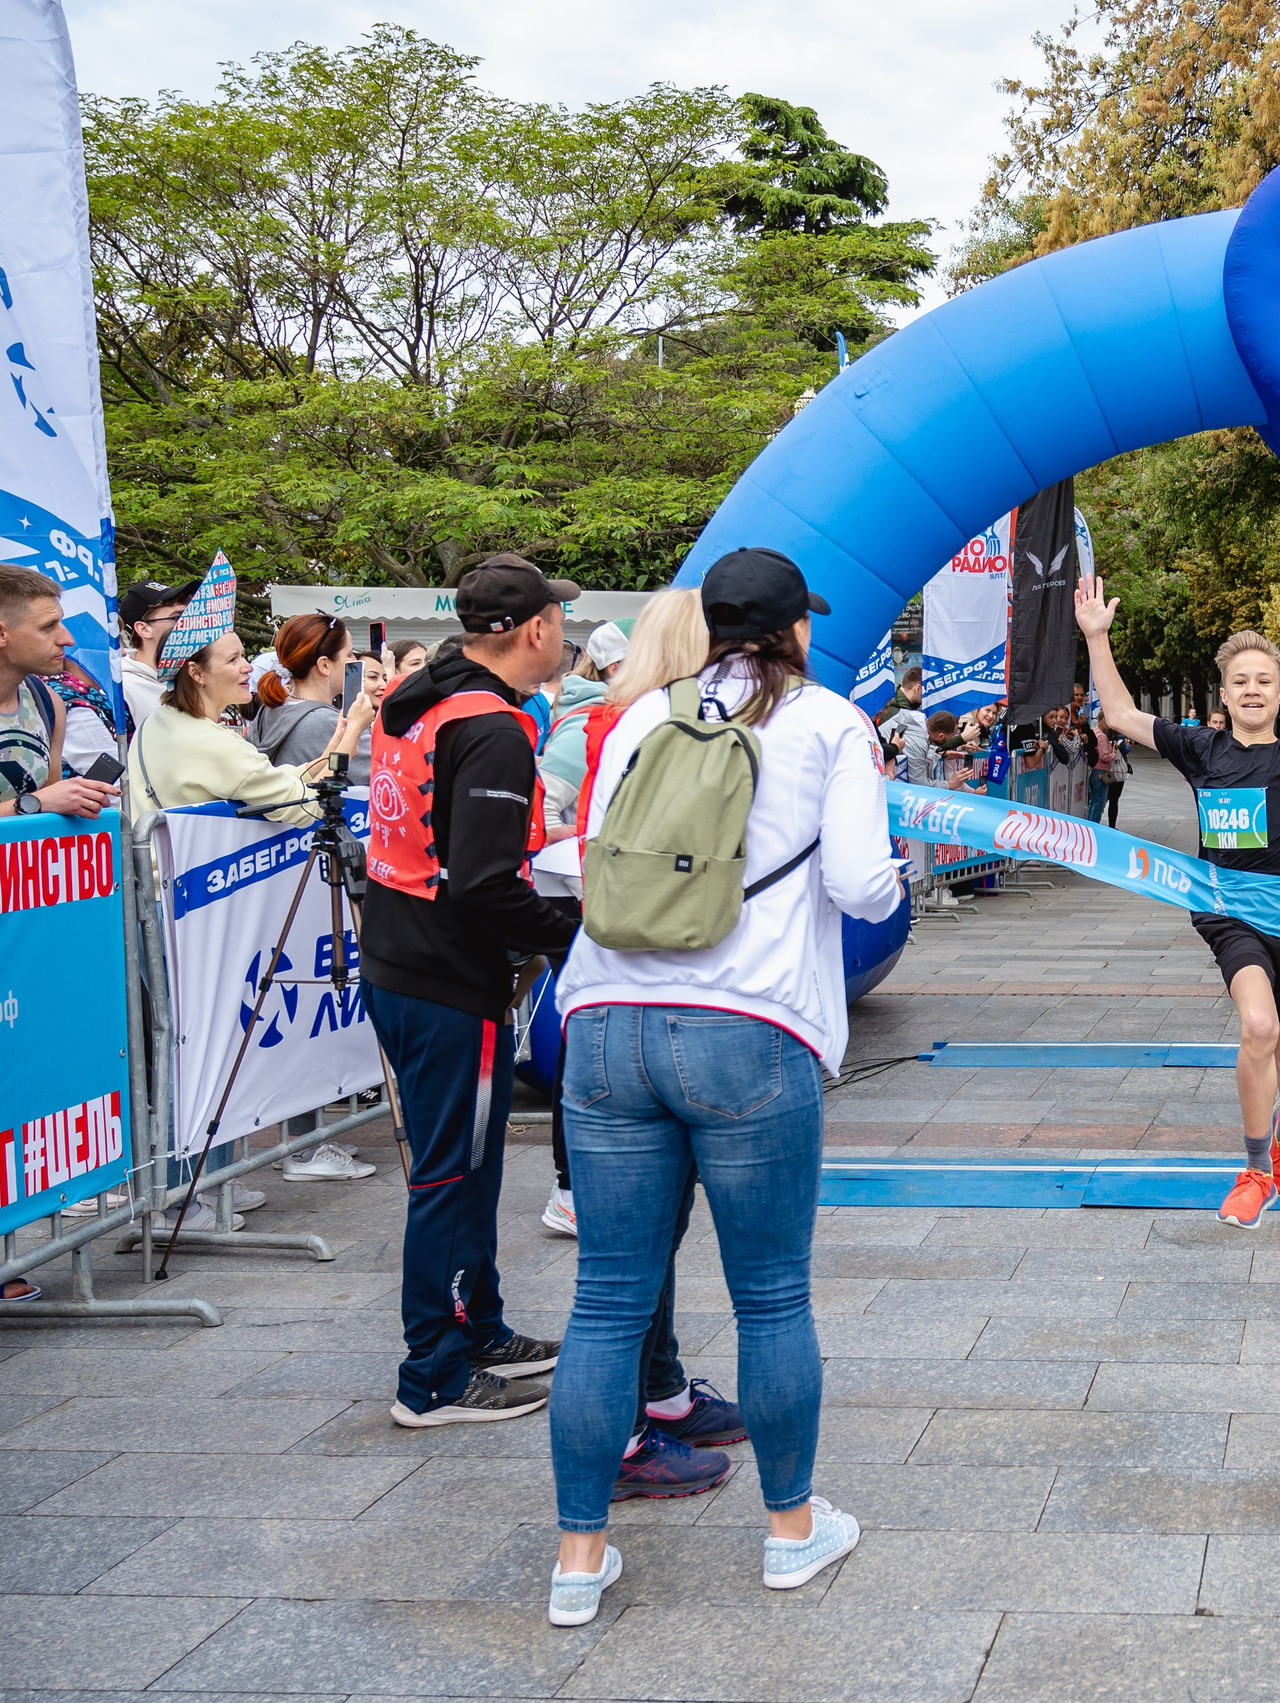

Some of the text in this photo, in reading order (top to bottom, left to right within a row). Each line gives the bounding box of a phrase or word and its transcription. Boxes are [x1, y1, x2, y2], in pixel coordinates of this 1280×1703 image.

[952, 556, 1007, 573] РАДИО
[1208, 808, 1250, 829] 10246
[207, 830, 316, 893] ЗАБЕГ.РФ
[899, 795, 975, 836] ЗАБЕГ
[994, 811, 1097, 867] ФИНИШ
[1153, 864, 1191, 893] ПСБ
[1217, 832, 1237, 849] 1KM
[23, 1091, 123, 1197] #ЦЕЛЬ
